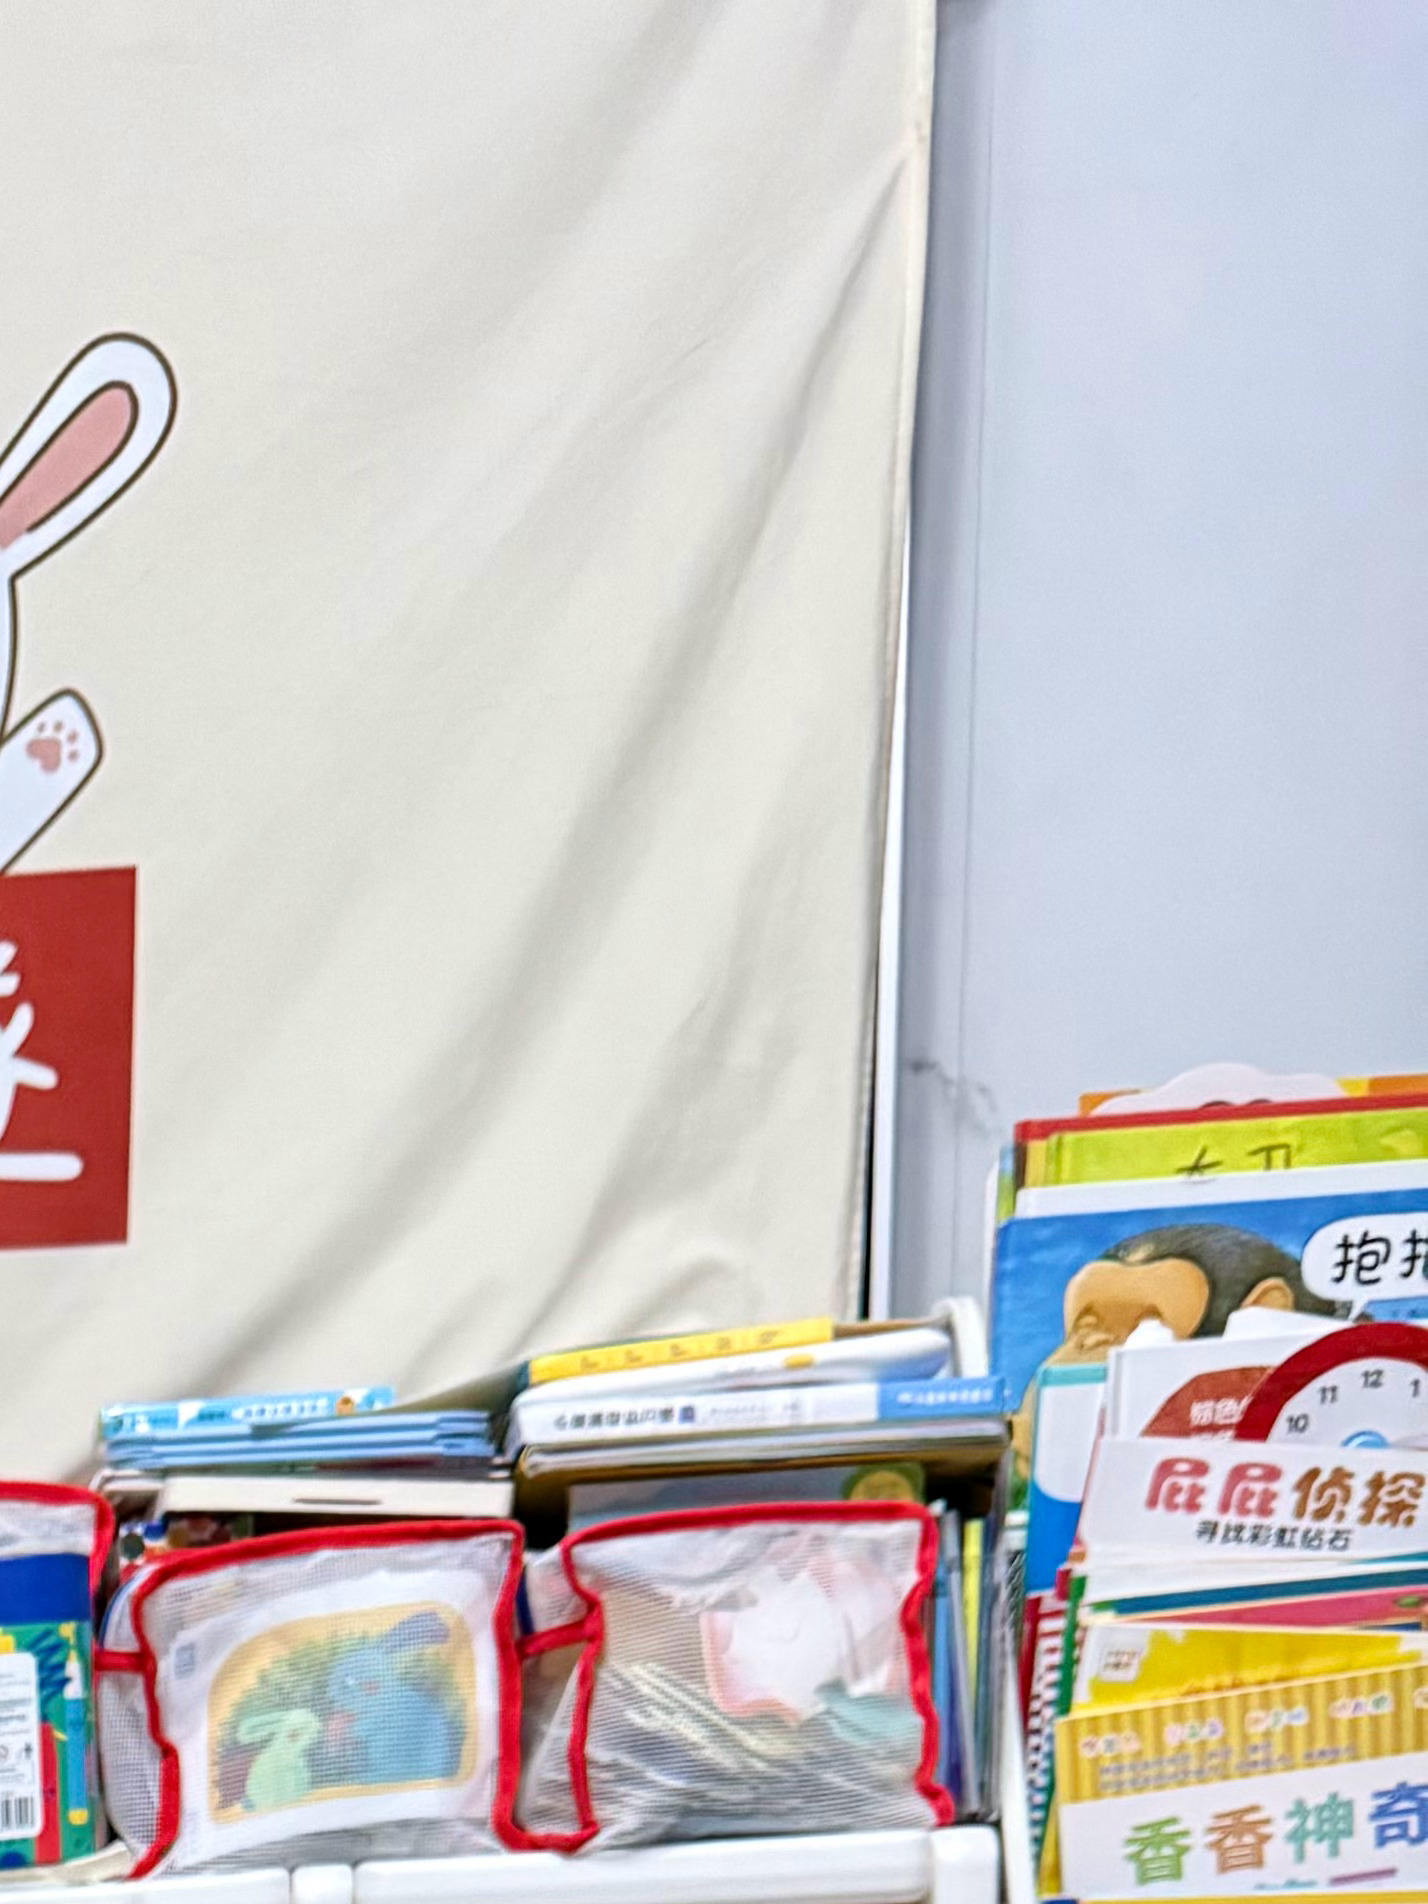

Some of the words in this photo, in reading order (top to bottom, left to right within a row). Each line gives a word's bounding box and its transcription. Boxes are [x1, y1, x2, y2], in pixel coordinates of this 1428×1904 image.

[1361, 1368, 1384, 1390] 12
[1409, 1377, 1421, 1398] 1
[1318, 1384, 1340, 1405] 11
[1286, 1412, 1310, 1434] 10
[1144, 1456, 1428, 1528] 屁屁侦探
[1195, 1518, 1354, 1551] 寻找彩虹钻石
[1123, 1780, 1428, 1886] 香香神奇
